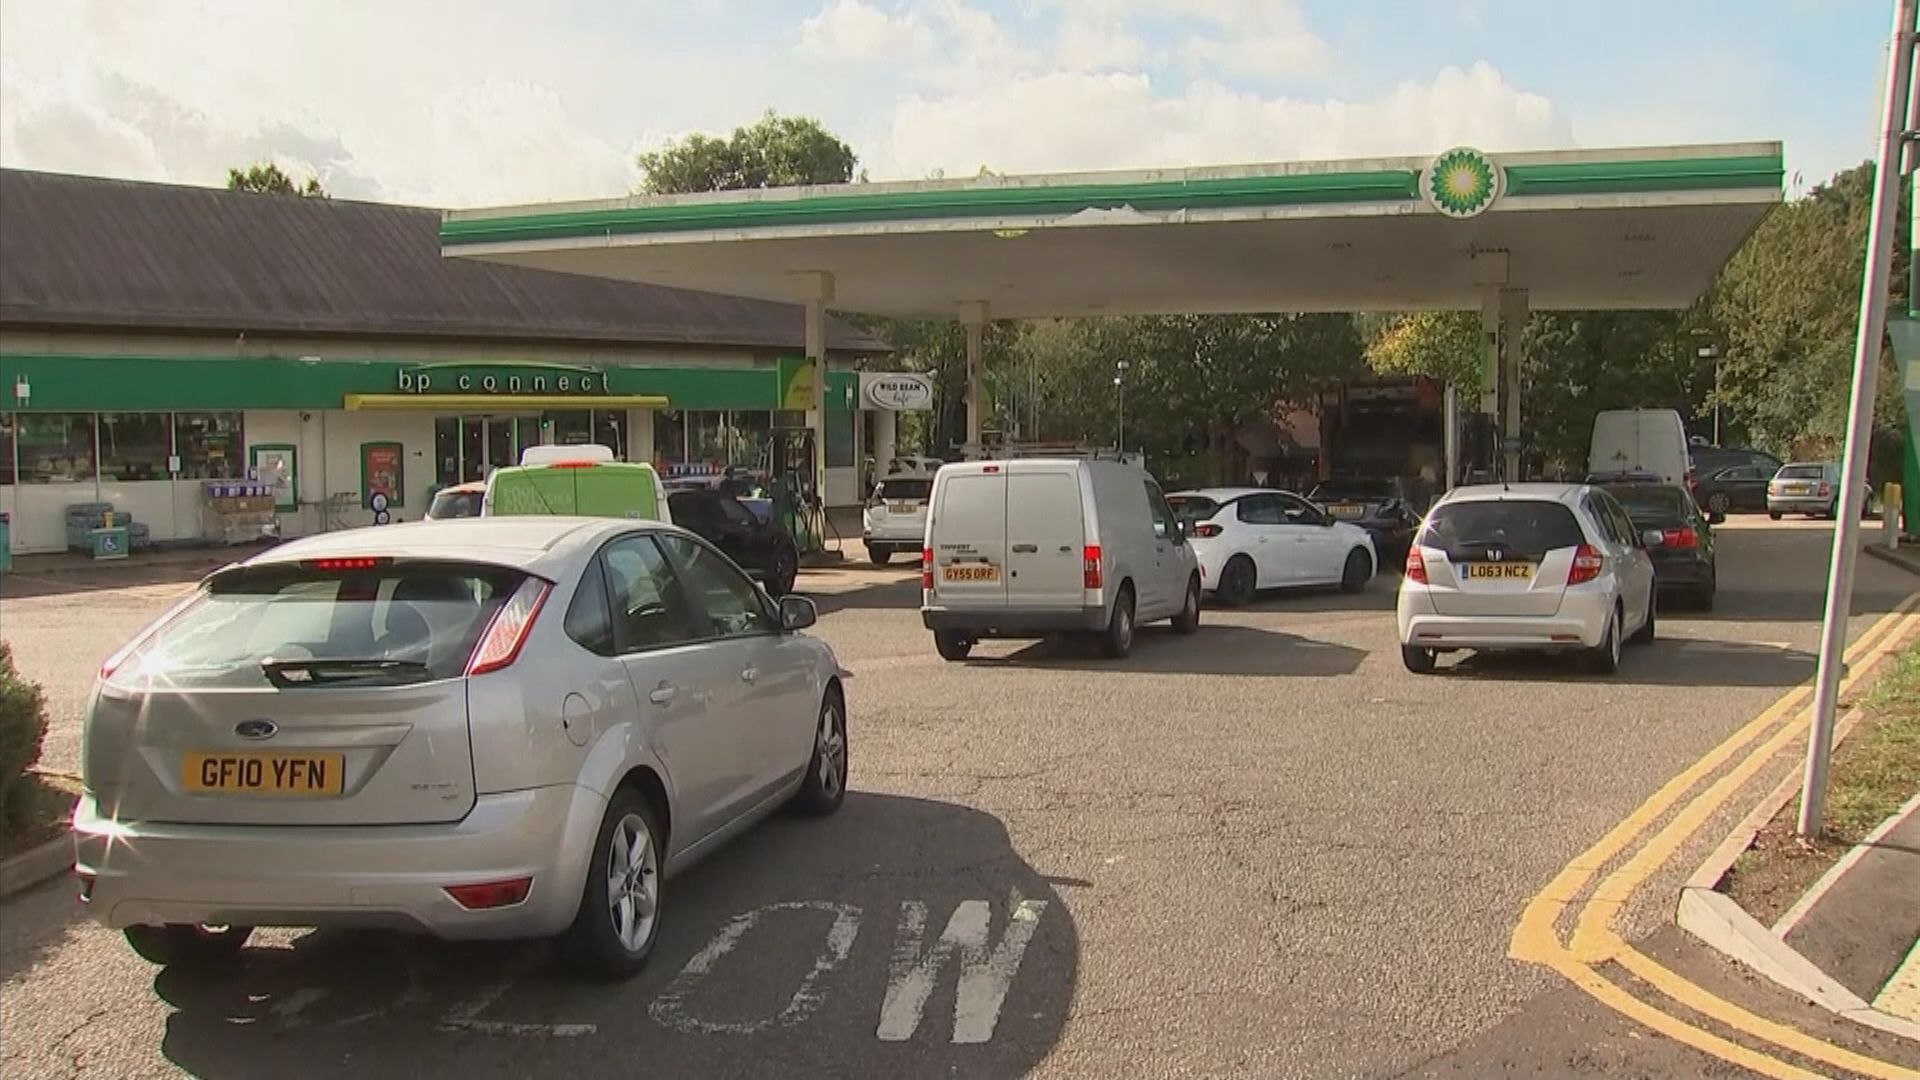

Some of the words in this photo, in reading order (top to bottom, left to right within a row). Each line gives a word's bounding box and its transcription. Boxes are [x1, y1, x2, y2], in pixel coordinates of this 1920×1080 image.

[399, 368, 431, 393] bp
[458, 370, 610, 394] connect
[879, 383, 898, 391] WILD
[1504, 565, 1529, 578] NCZ
[201, 758, 263, 788] GF10
[272, 759, 326, 789] YFN
